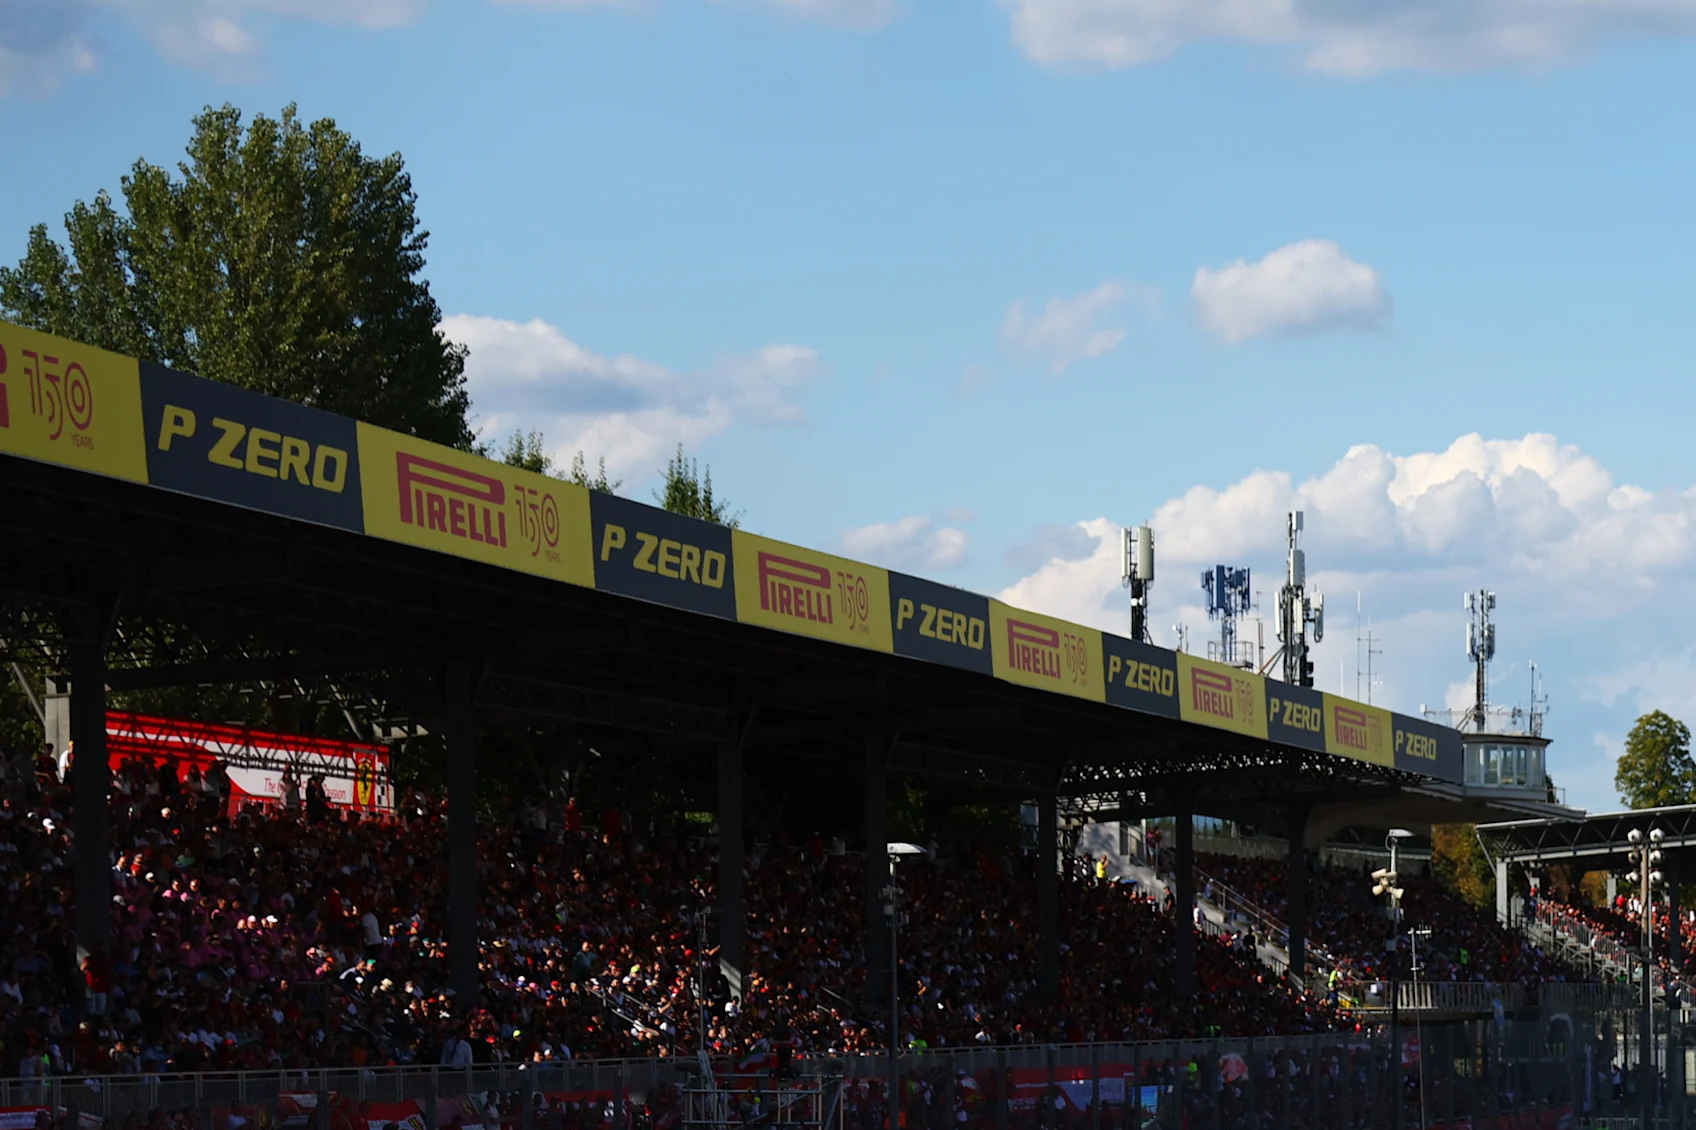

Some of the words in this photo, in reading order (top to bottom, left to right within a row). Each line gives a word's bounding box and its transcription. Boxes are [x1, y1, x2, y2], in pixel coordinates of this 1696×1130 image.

[158, 404, 196, 451] P
[208, 418, 348, 493] ZERO
[396, 451, 507, 548] PIRELLI
[601, 523, 626, 562] P
[633, 532, 726, 590] ZERO
[757, 551, 833, 625] PIRELLI
[896, 599, 914, 631] P
[919, 604, 985, 651] ZERO
[1007, 618, 1061, 679] PIRELLI
[1109, 655, 1122, 684] P
[1125, 659, 1174, 697] ZERO
[1191, 667, 1234, 720] PIRELLI
[1269, 697, 1280, 723] P
[1283, 702, 1321, 734] ZERO
[1334, 705, 1367, 751] PIRELLI
[1395, 730, 1403, 753] P
[1406, 732, 1437, 761] ZERO
